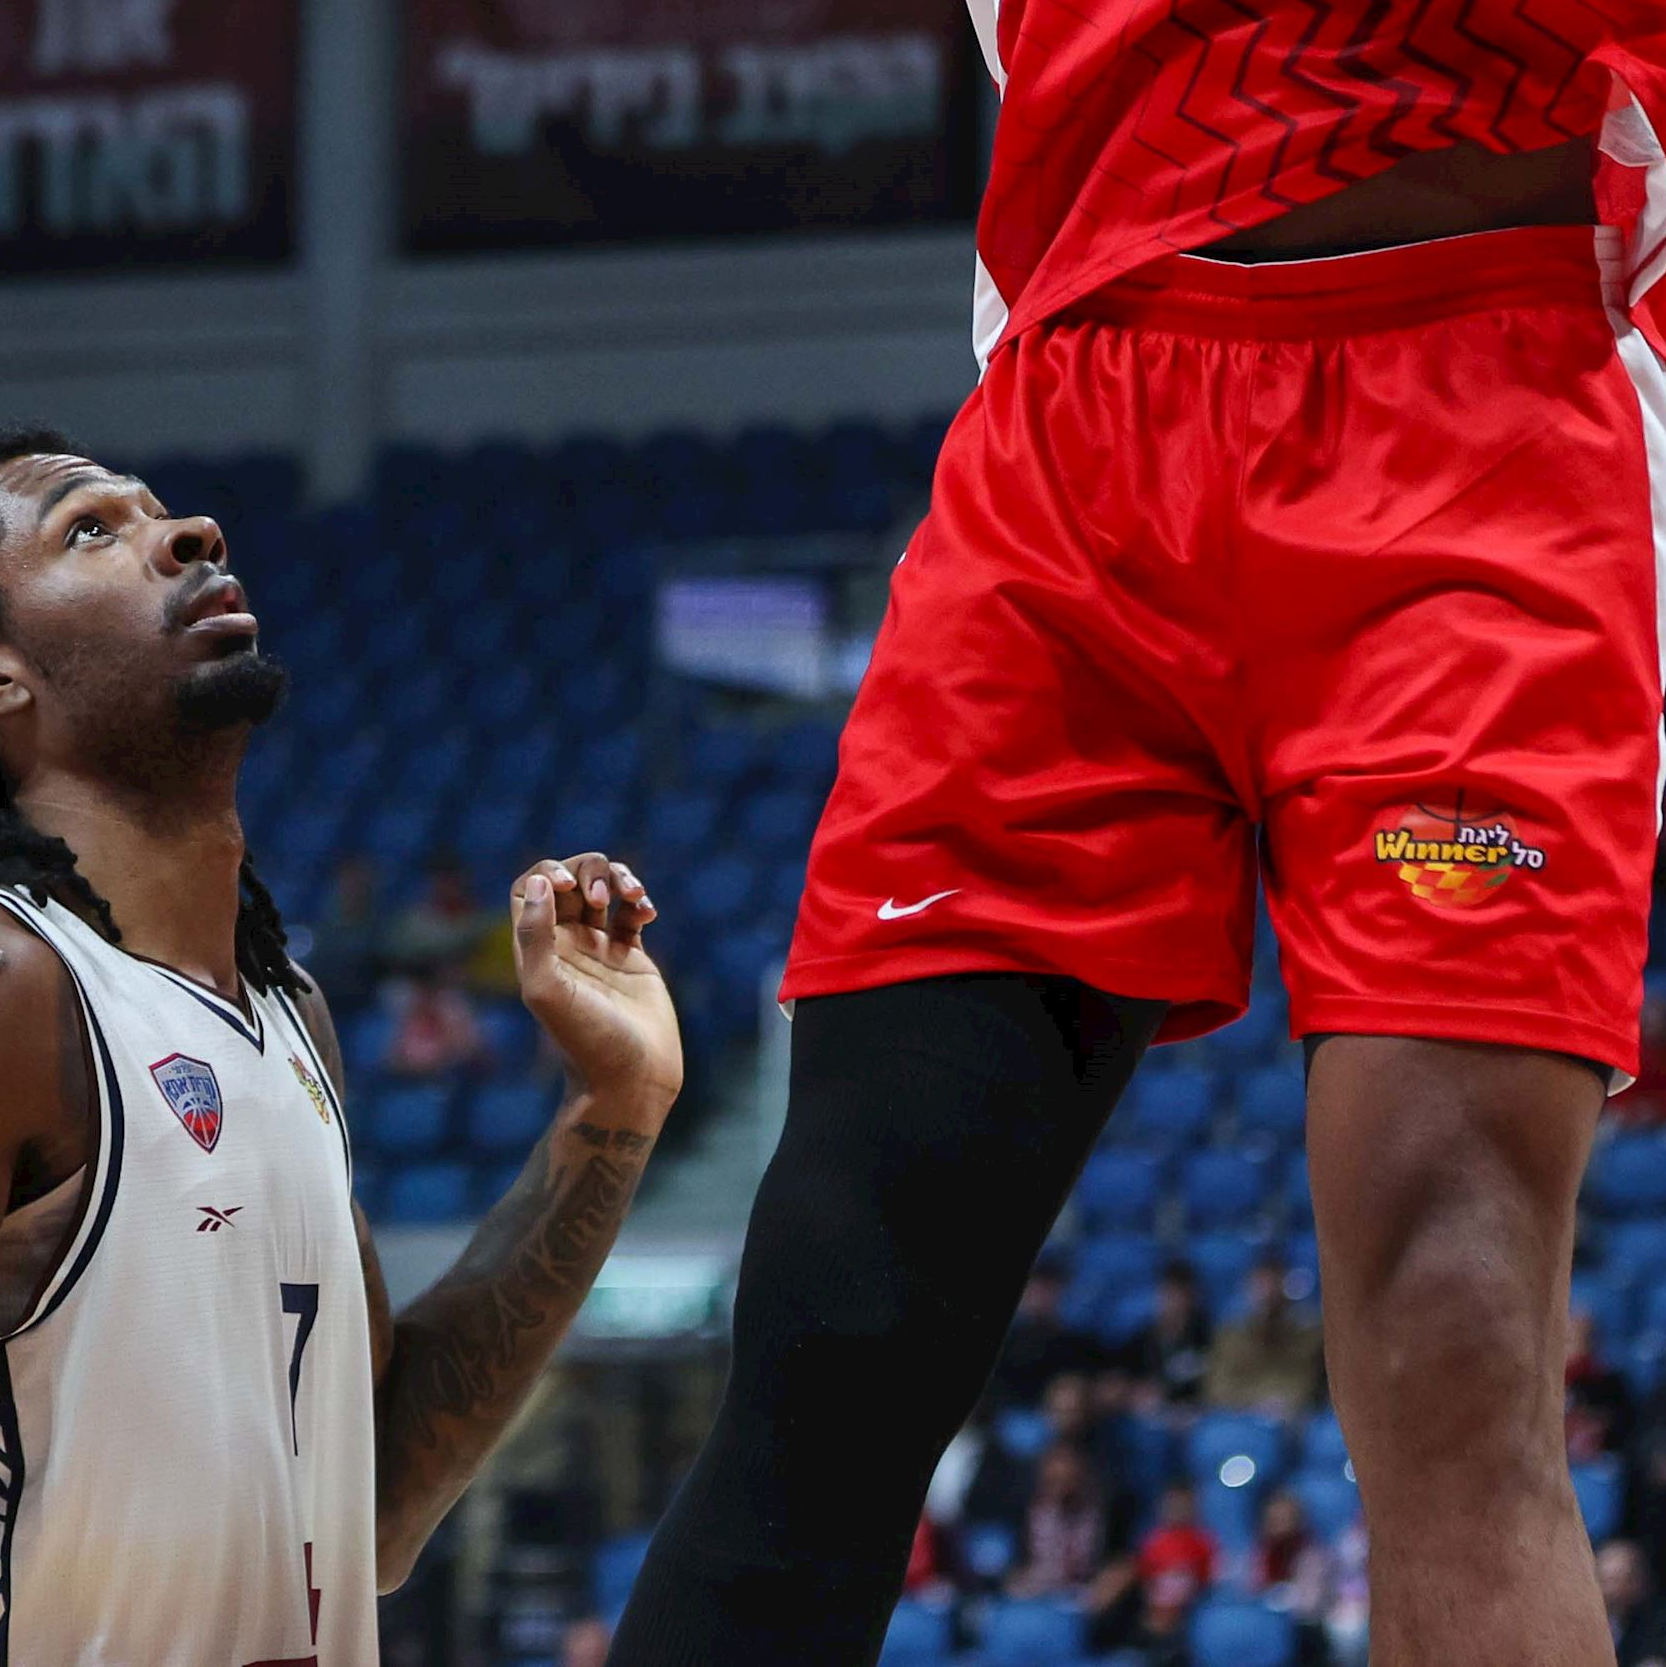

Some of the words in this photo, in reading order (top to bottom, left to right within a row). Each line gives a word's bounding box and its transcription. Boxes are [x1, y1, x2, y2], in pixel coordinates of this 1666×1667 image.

[1374, 831, 1510, 865] Winner
[1456, 823, 1511, 845] ליגת
[1510, 840, 1545, 869] סל
[279, 1282, 320, 1457] 7
